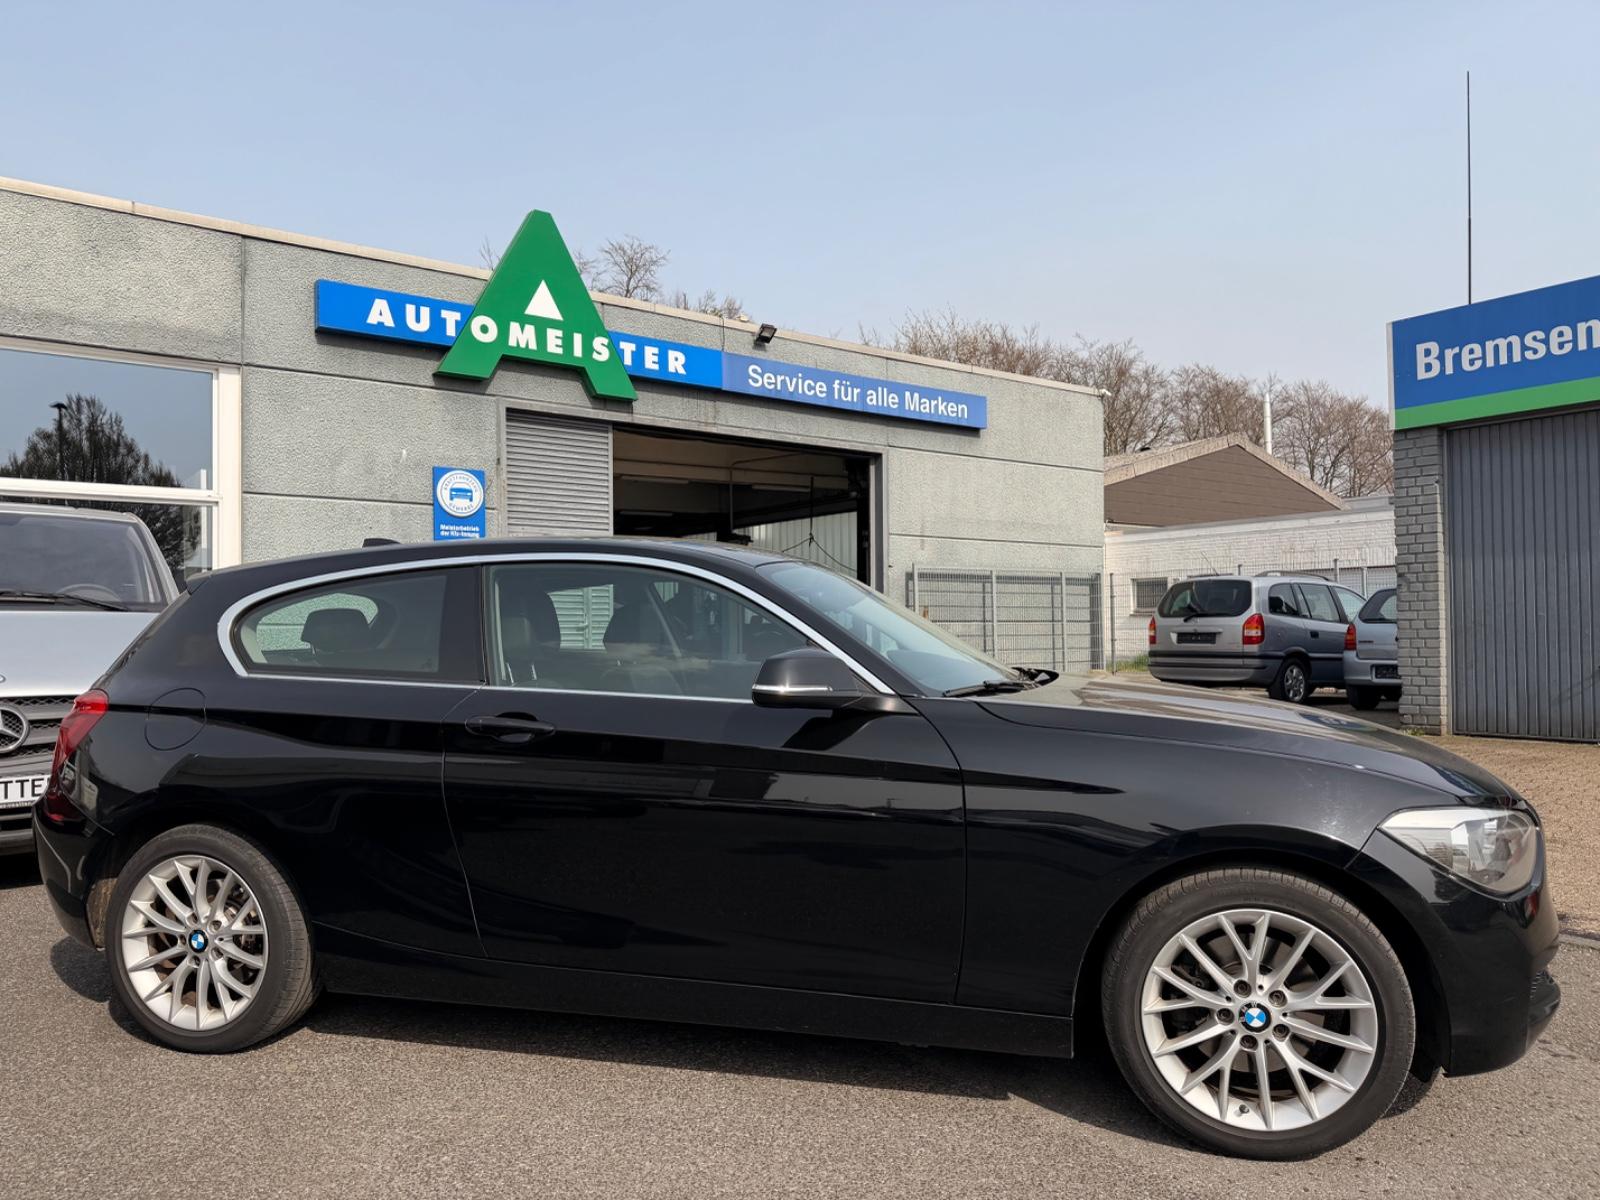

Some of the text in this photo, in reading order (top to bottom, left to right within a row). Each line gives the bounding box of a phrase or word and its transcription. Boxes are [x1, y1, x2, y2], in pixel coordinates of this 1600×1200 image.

[366, 298, 687, 375] AUTOMEISTER
[1416, 319, 1600, 381] Bremsen
[748, 364, 969, 420] Service für alle Marken
